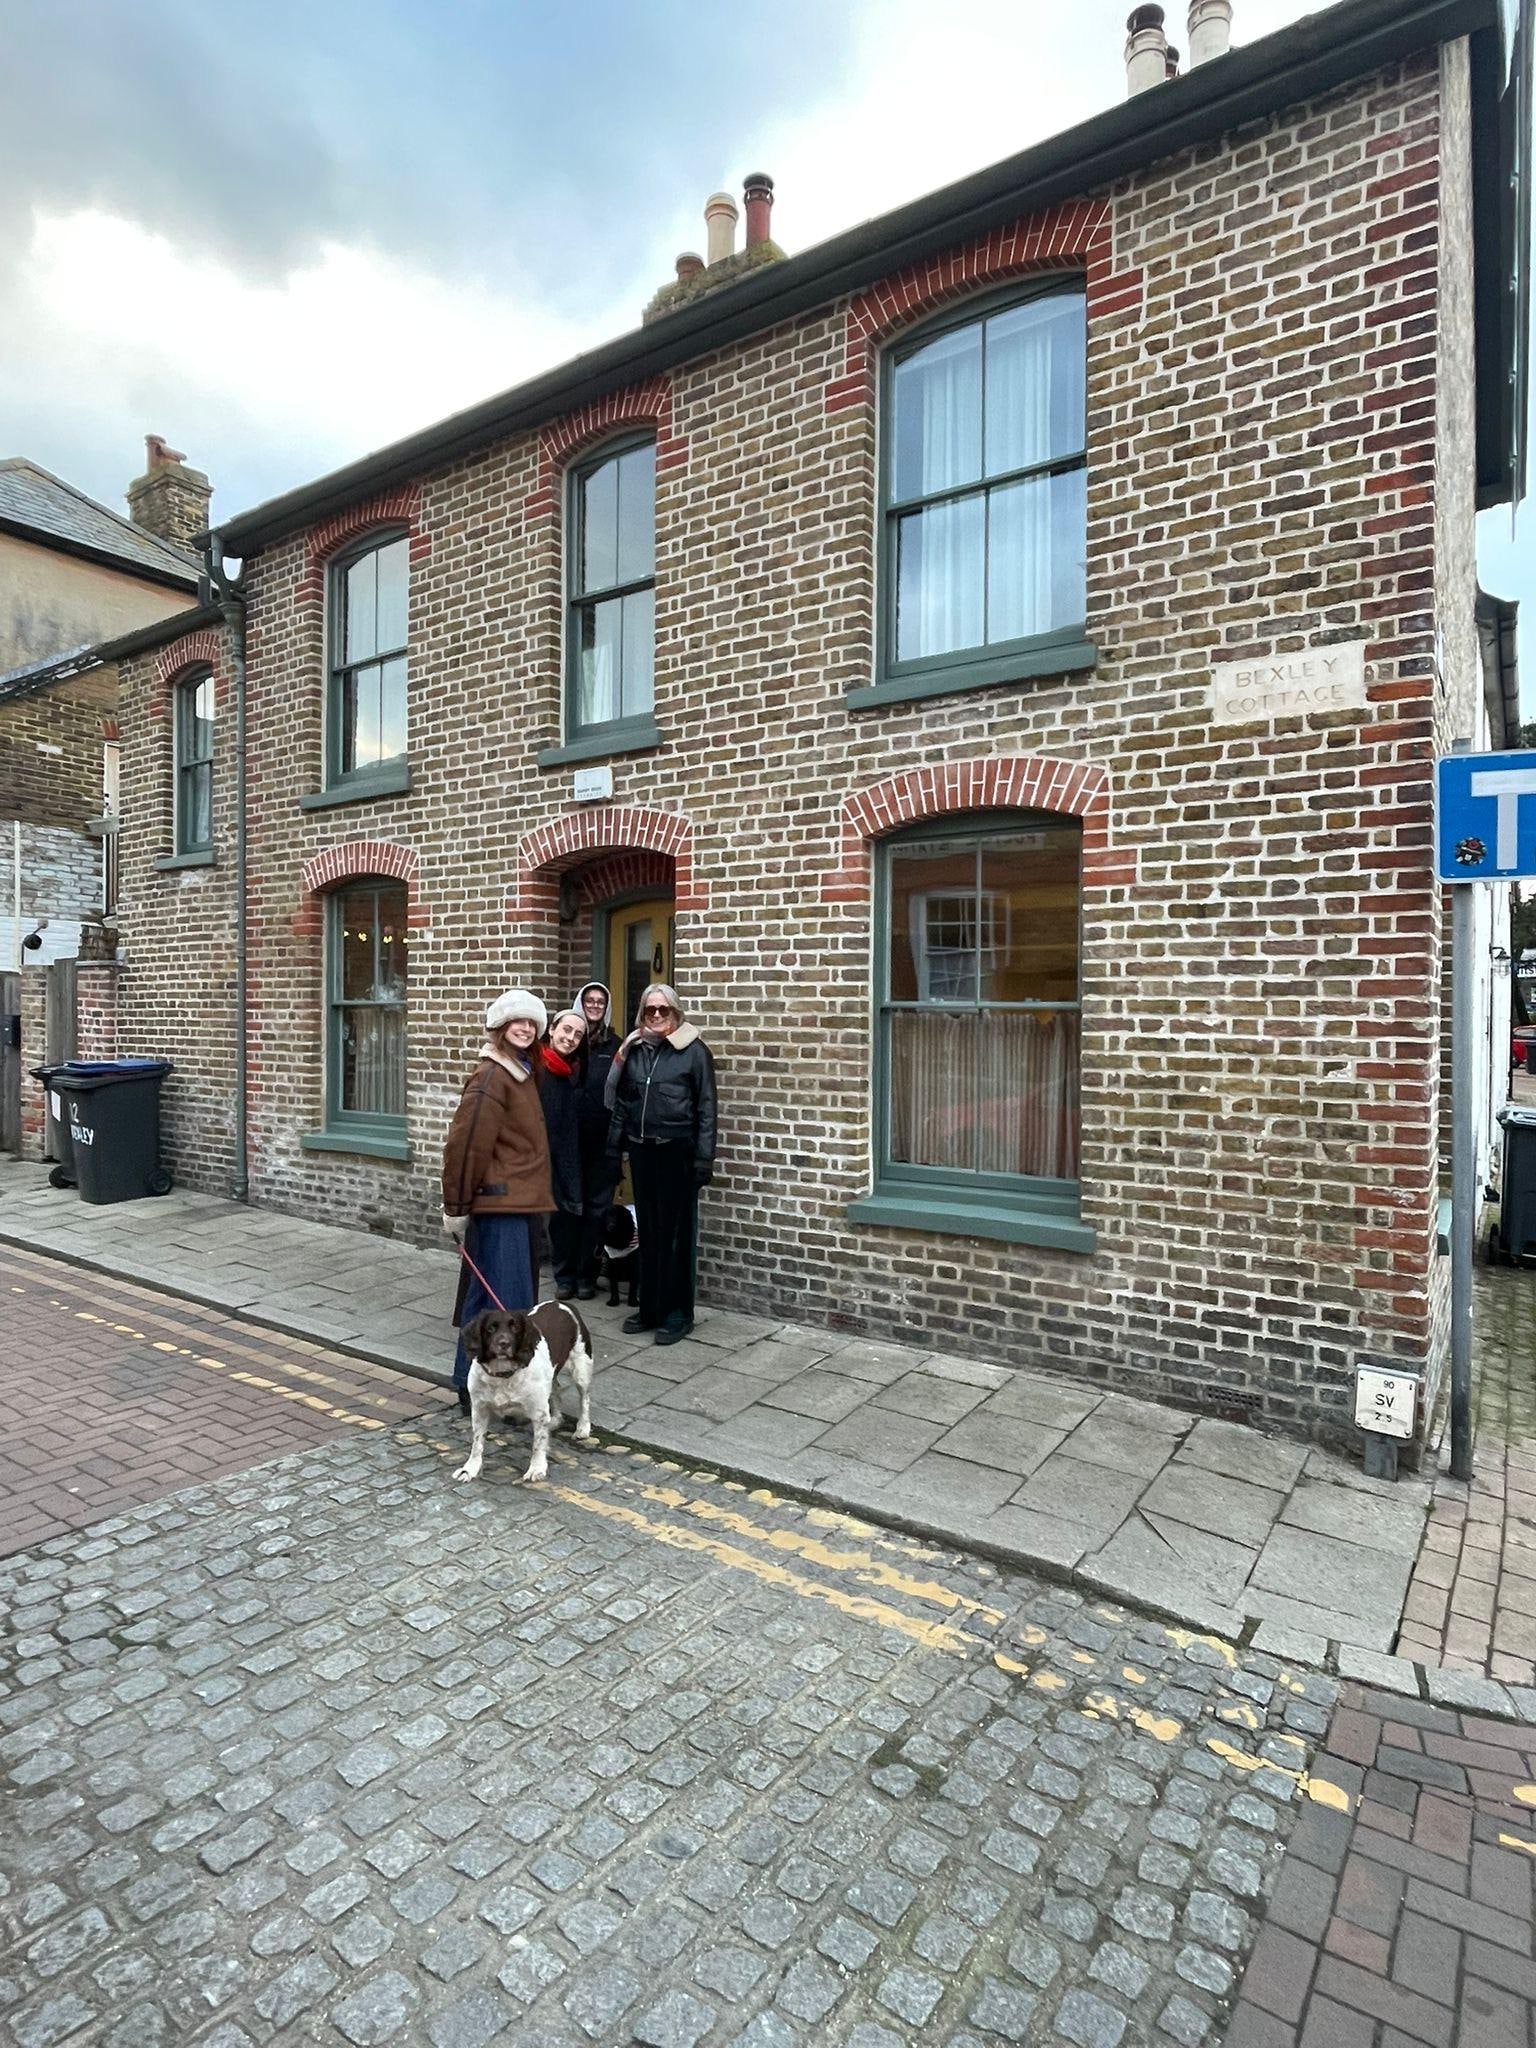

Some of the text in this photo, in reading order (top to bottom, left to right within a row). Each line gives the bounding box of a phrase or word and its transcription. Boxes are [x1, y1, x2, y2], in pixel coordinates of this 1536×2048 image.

[1236, 657, 1337, 688] BEXLEY
[1225, 683, 1345, 715] COTTAGE
[1383, 1380, 1395, 1389] 90
[1375, 1393, 1394, 1408] SV
